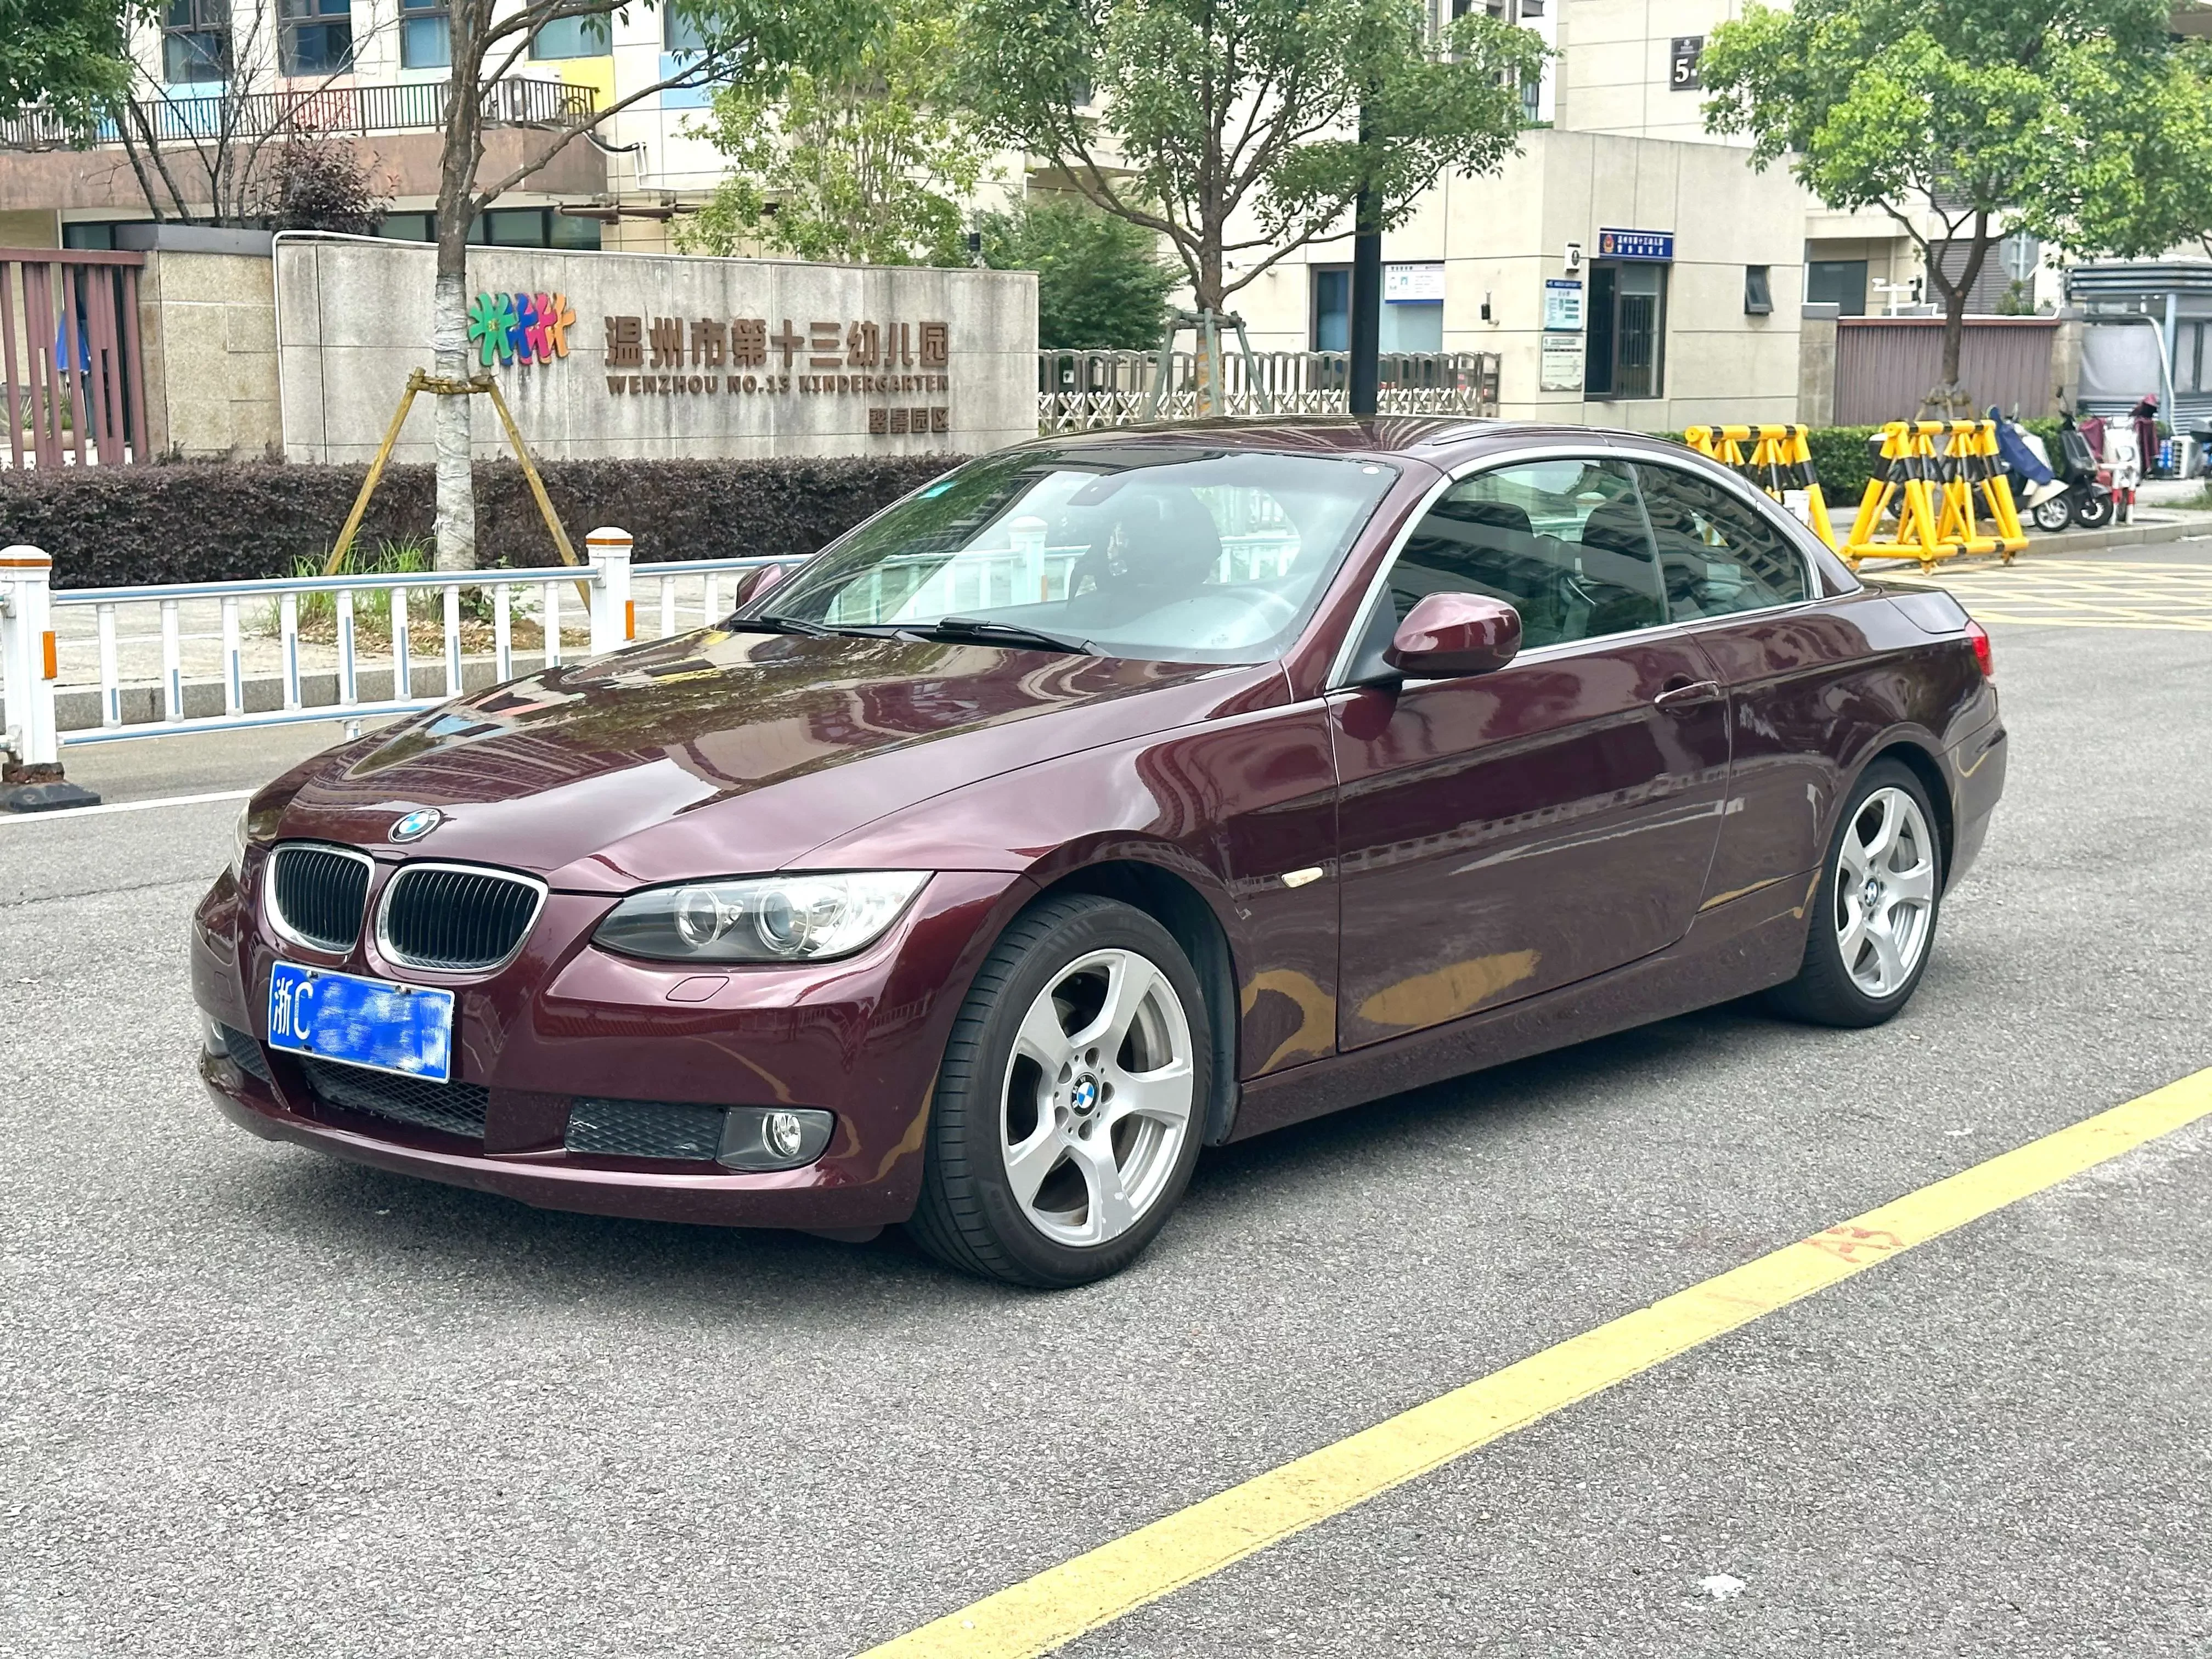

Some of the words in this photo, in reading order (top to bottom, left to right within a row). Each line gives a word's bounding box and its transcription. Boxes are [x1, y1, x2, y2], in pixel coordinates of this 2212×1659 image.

[1674, 58, 1690, 82] 5
[605, 316, 949, 368] 温州市第十三幼儿园
[606, 375, 718, 395] WENZHOU
[799, 375, 949, 393] KINDERGARTEN
